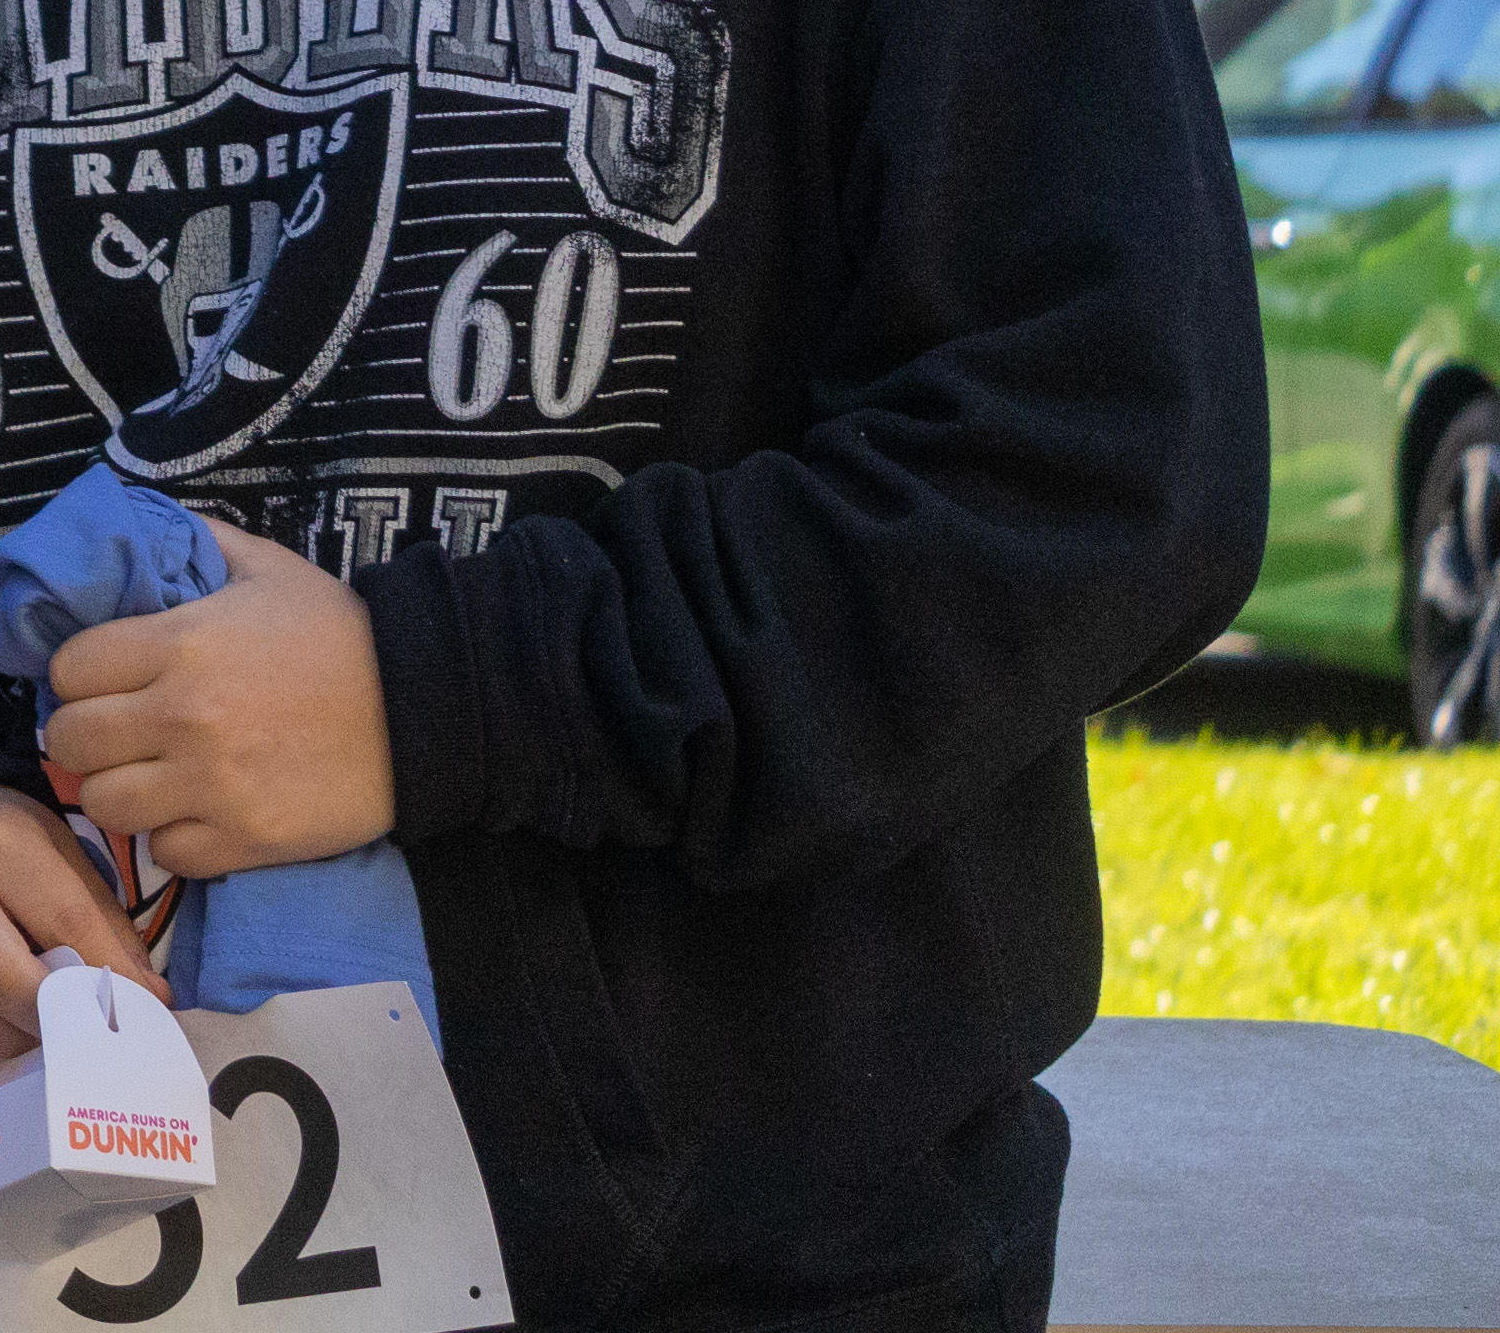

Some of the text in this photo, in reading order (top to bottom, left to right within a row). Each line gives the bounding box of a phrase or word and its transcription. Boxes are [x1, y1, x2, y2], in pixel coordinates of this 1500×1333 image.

[72, 112, 354, 197] RAIDERS
[427, 229, 621, 423] 60
[67, 1106, 190, 1132] AMERICA RUNS ON
[68, 1120, 198, 1164] DUNKIN'
